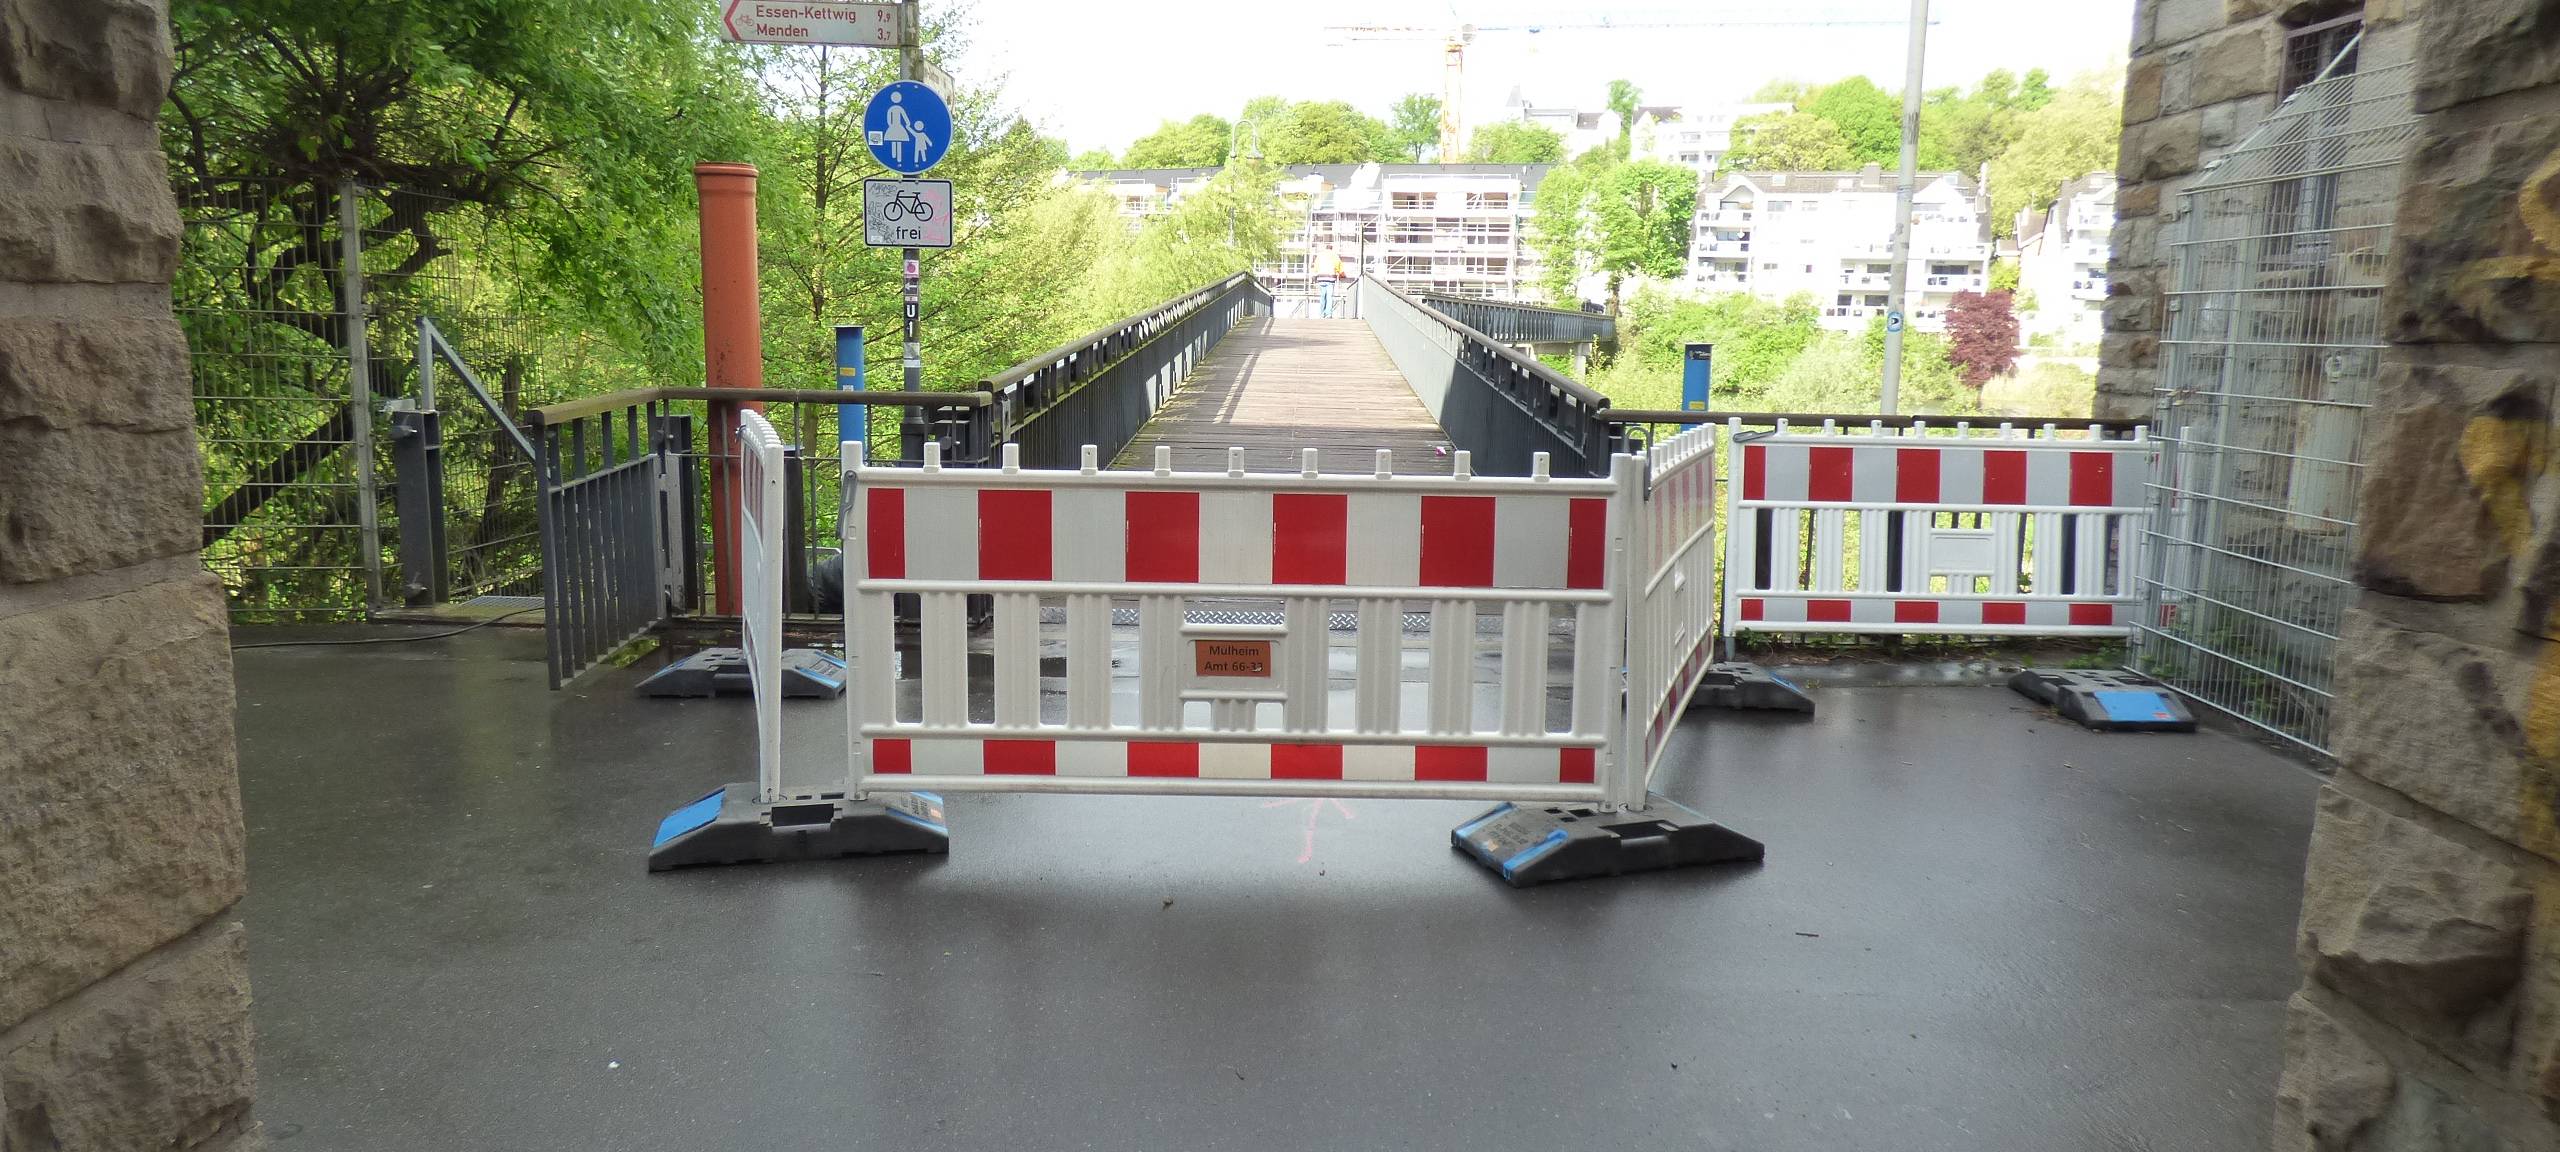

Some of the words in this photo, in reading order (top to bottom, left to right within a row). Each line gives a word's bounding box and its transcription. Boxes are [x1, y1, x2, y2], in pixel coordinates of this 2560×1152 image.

[756, 5, 857, 24] Essen-Kettwig
[756, 24, 809, 37] Menden
[896, 226, 921, 240] frei
[1204, 661, 1228, 671] Amt
